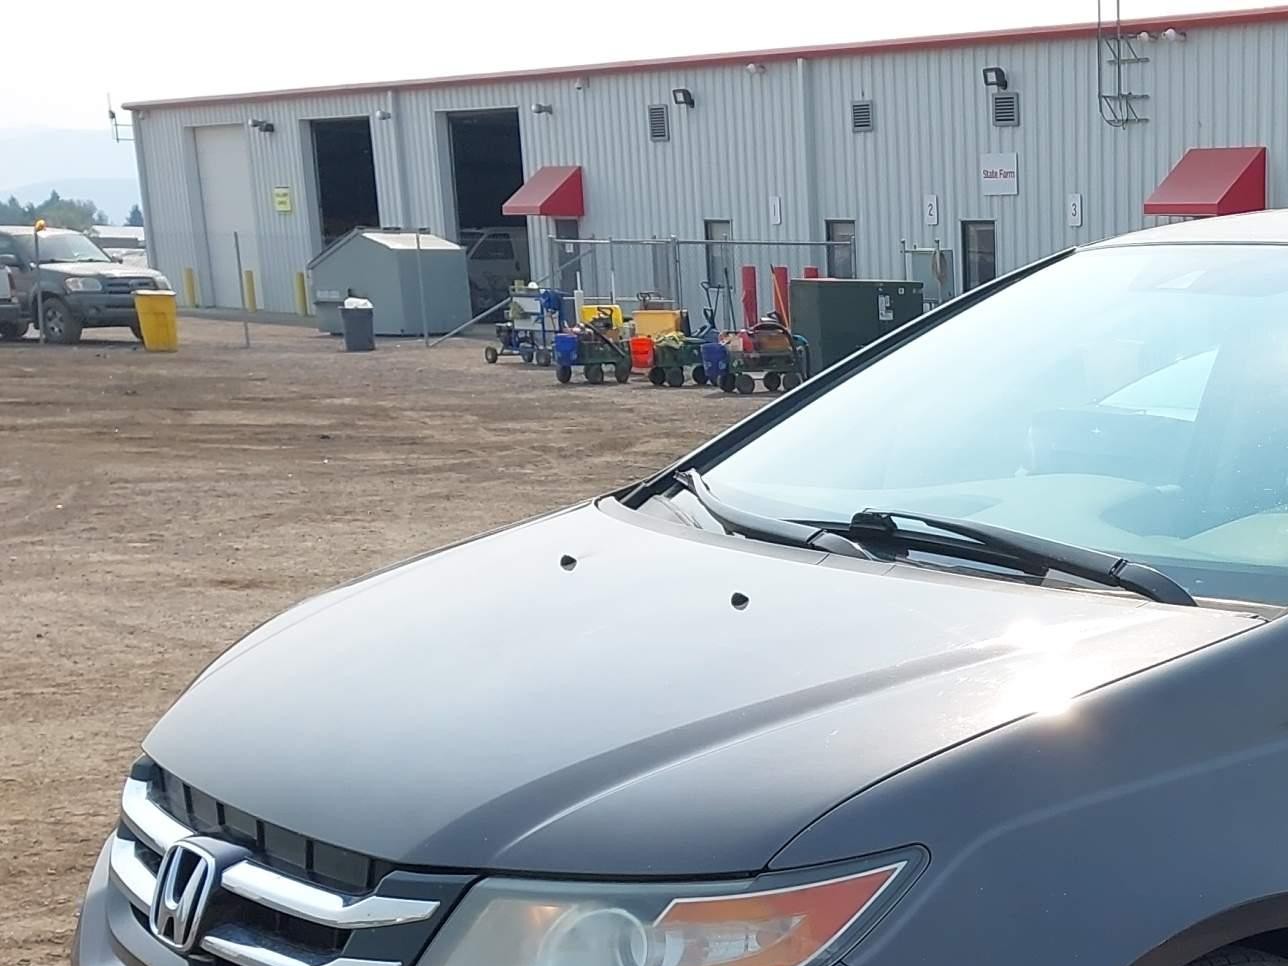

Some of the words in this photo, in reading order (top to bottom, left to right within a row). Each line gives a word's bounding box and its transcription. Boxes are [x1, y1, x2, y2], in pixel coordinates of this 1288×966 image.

[983, 169, 999, 179] State
[999, 168, 1015, 179] Farm
[927, 203, 934, 217] 2
[1071, 202, 1077, 217] 3
